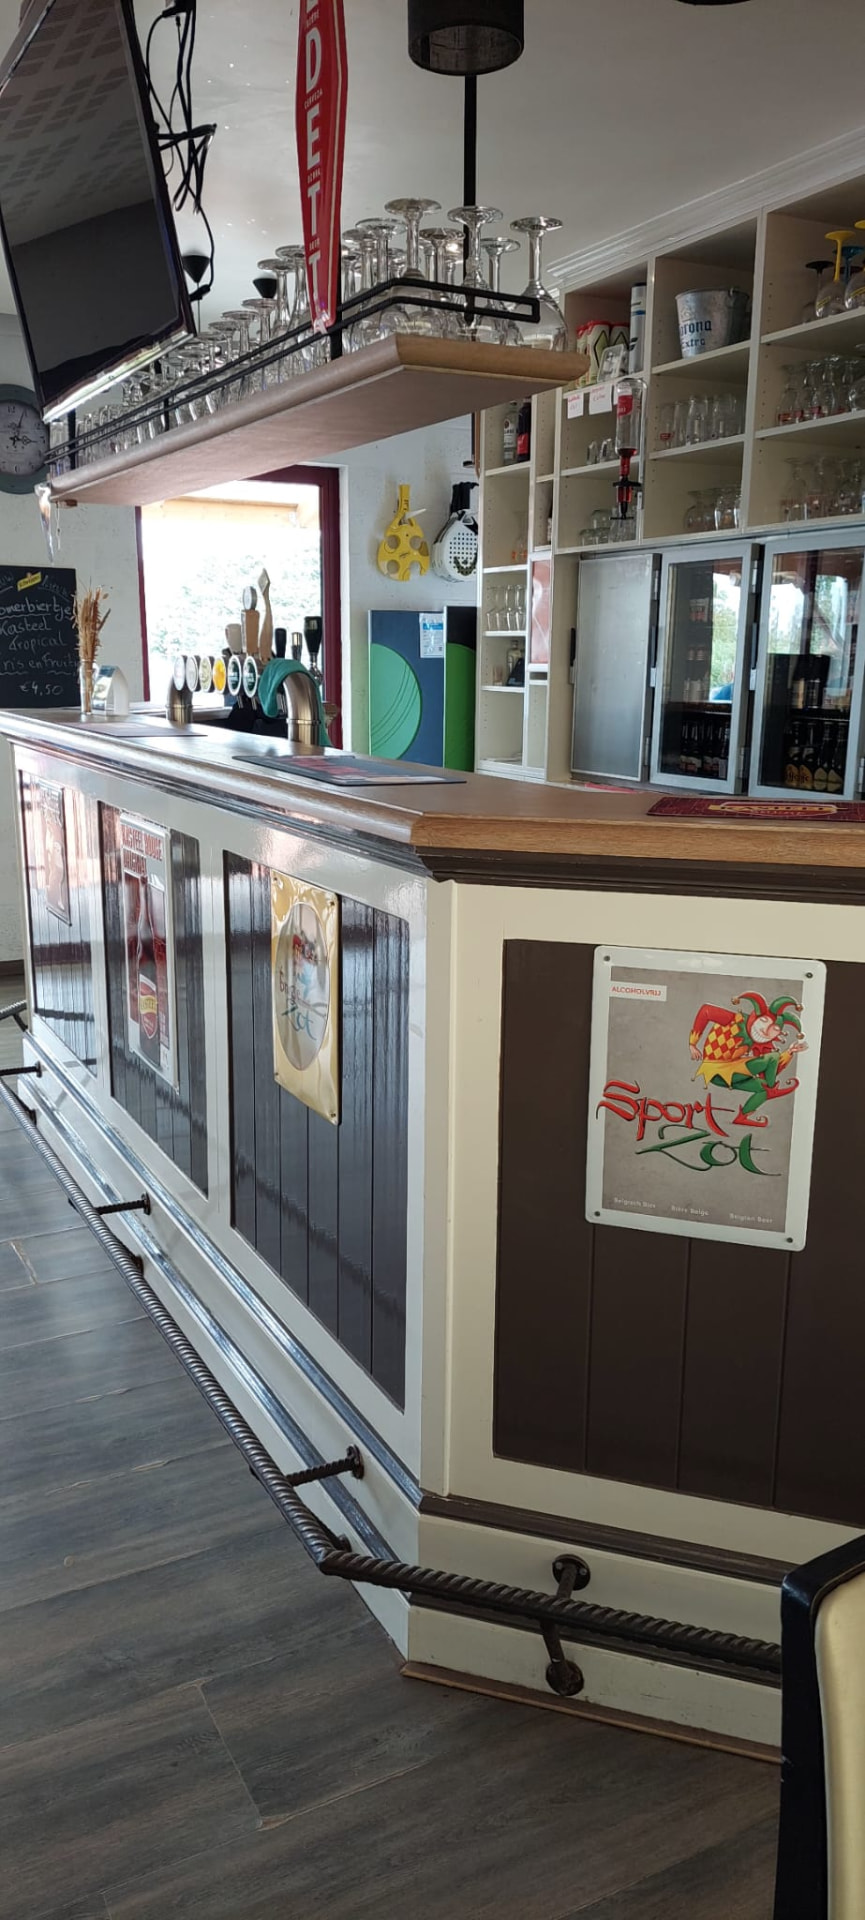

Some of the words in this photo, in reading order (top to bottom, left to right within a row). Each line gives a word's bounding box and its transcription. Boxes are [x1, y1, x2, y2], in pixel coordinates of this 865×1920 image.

[680, 320, 712, 336] orona
[0, 596, 72, 622] omerbiertje
[596, 1079, 735, 1141] Sport
[635, 1124, 782, 1177] Zot
